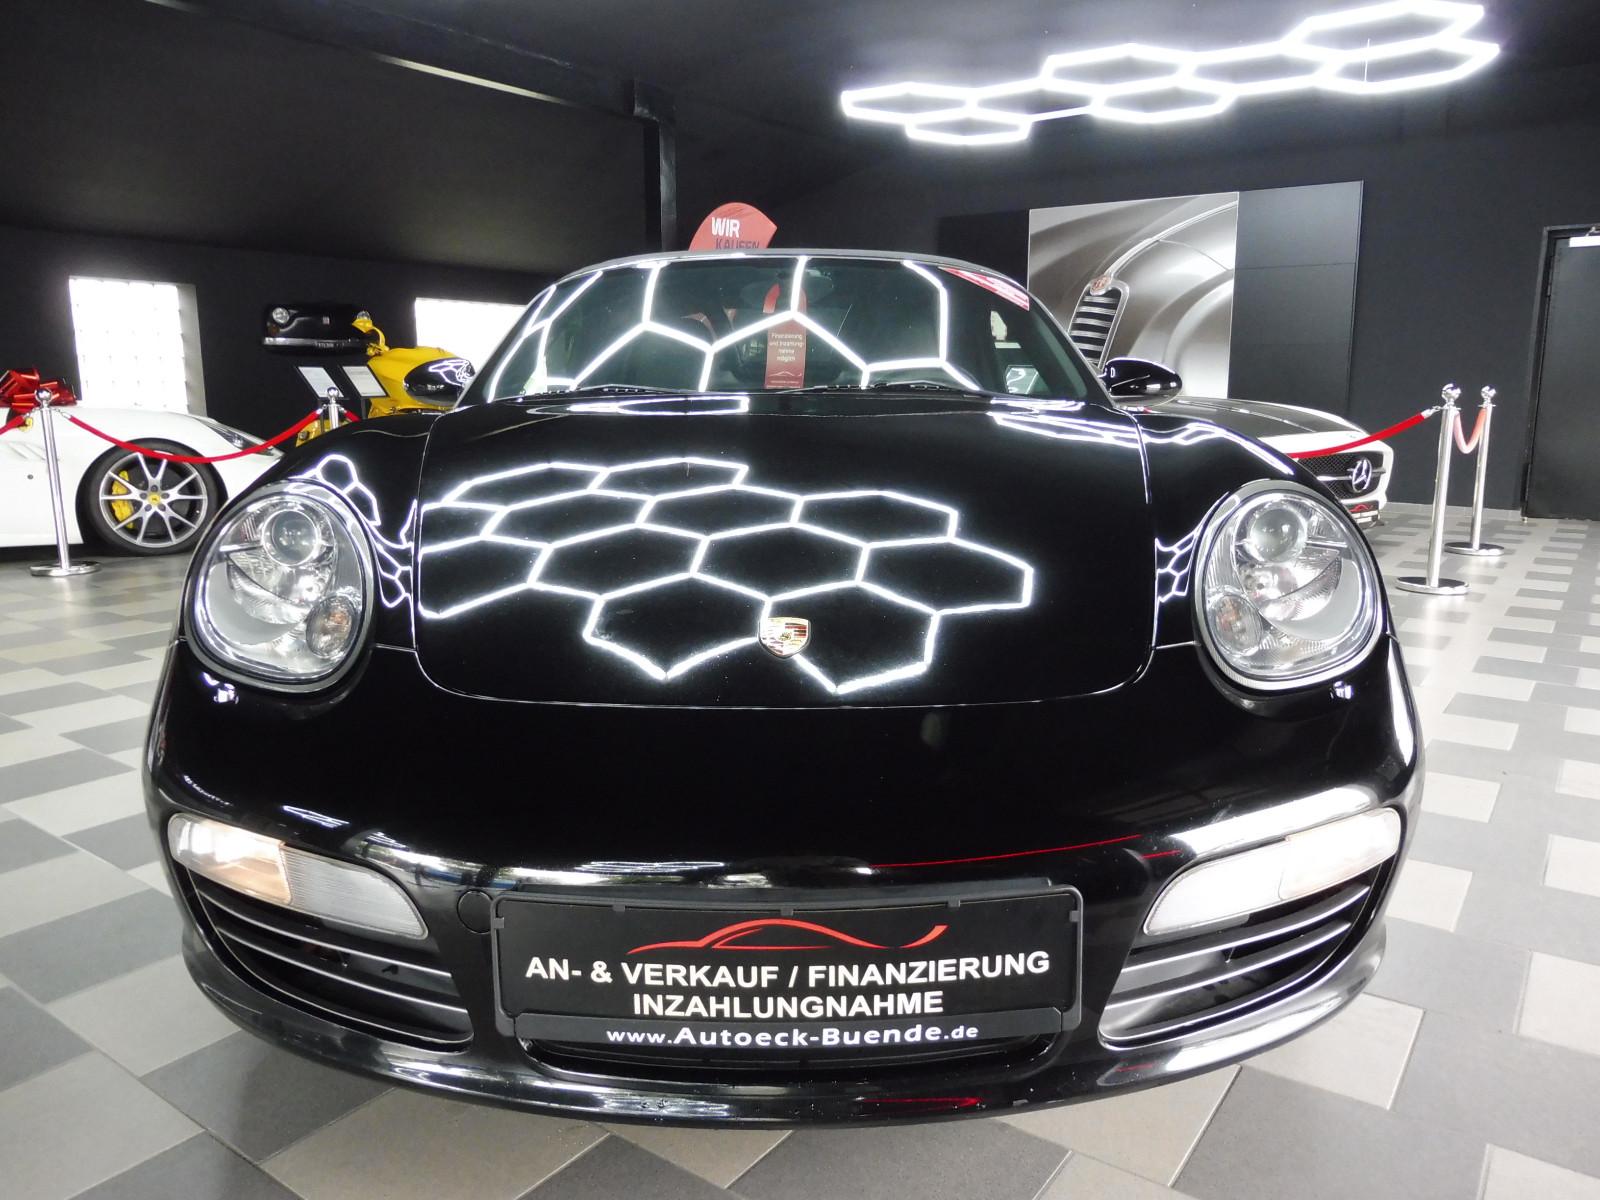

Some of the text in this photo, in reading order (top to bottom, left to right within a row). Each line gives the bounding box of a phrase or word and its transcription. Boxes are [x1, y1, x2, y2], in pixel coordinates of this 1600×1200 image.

[711, 216, 740, 238] WIR
[525, 950, 1050, 988] AN- & VERKAUF / FINANZIERUNG
[633, 990, 944, 1019] INZAHLUNGNAHME
[606, 1023, 979, 1047] www.Autoeck-Buende.de
